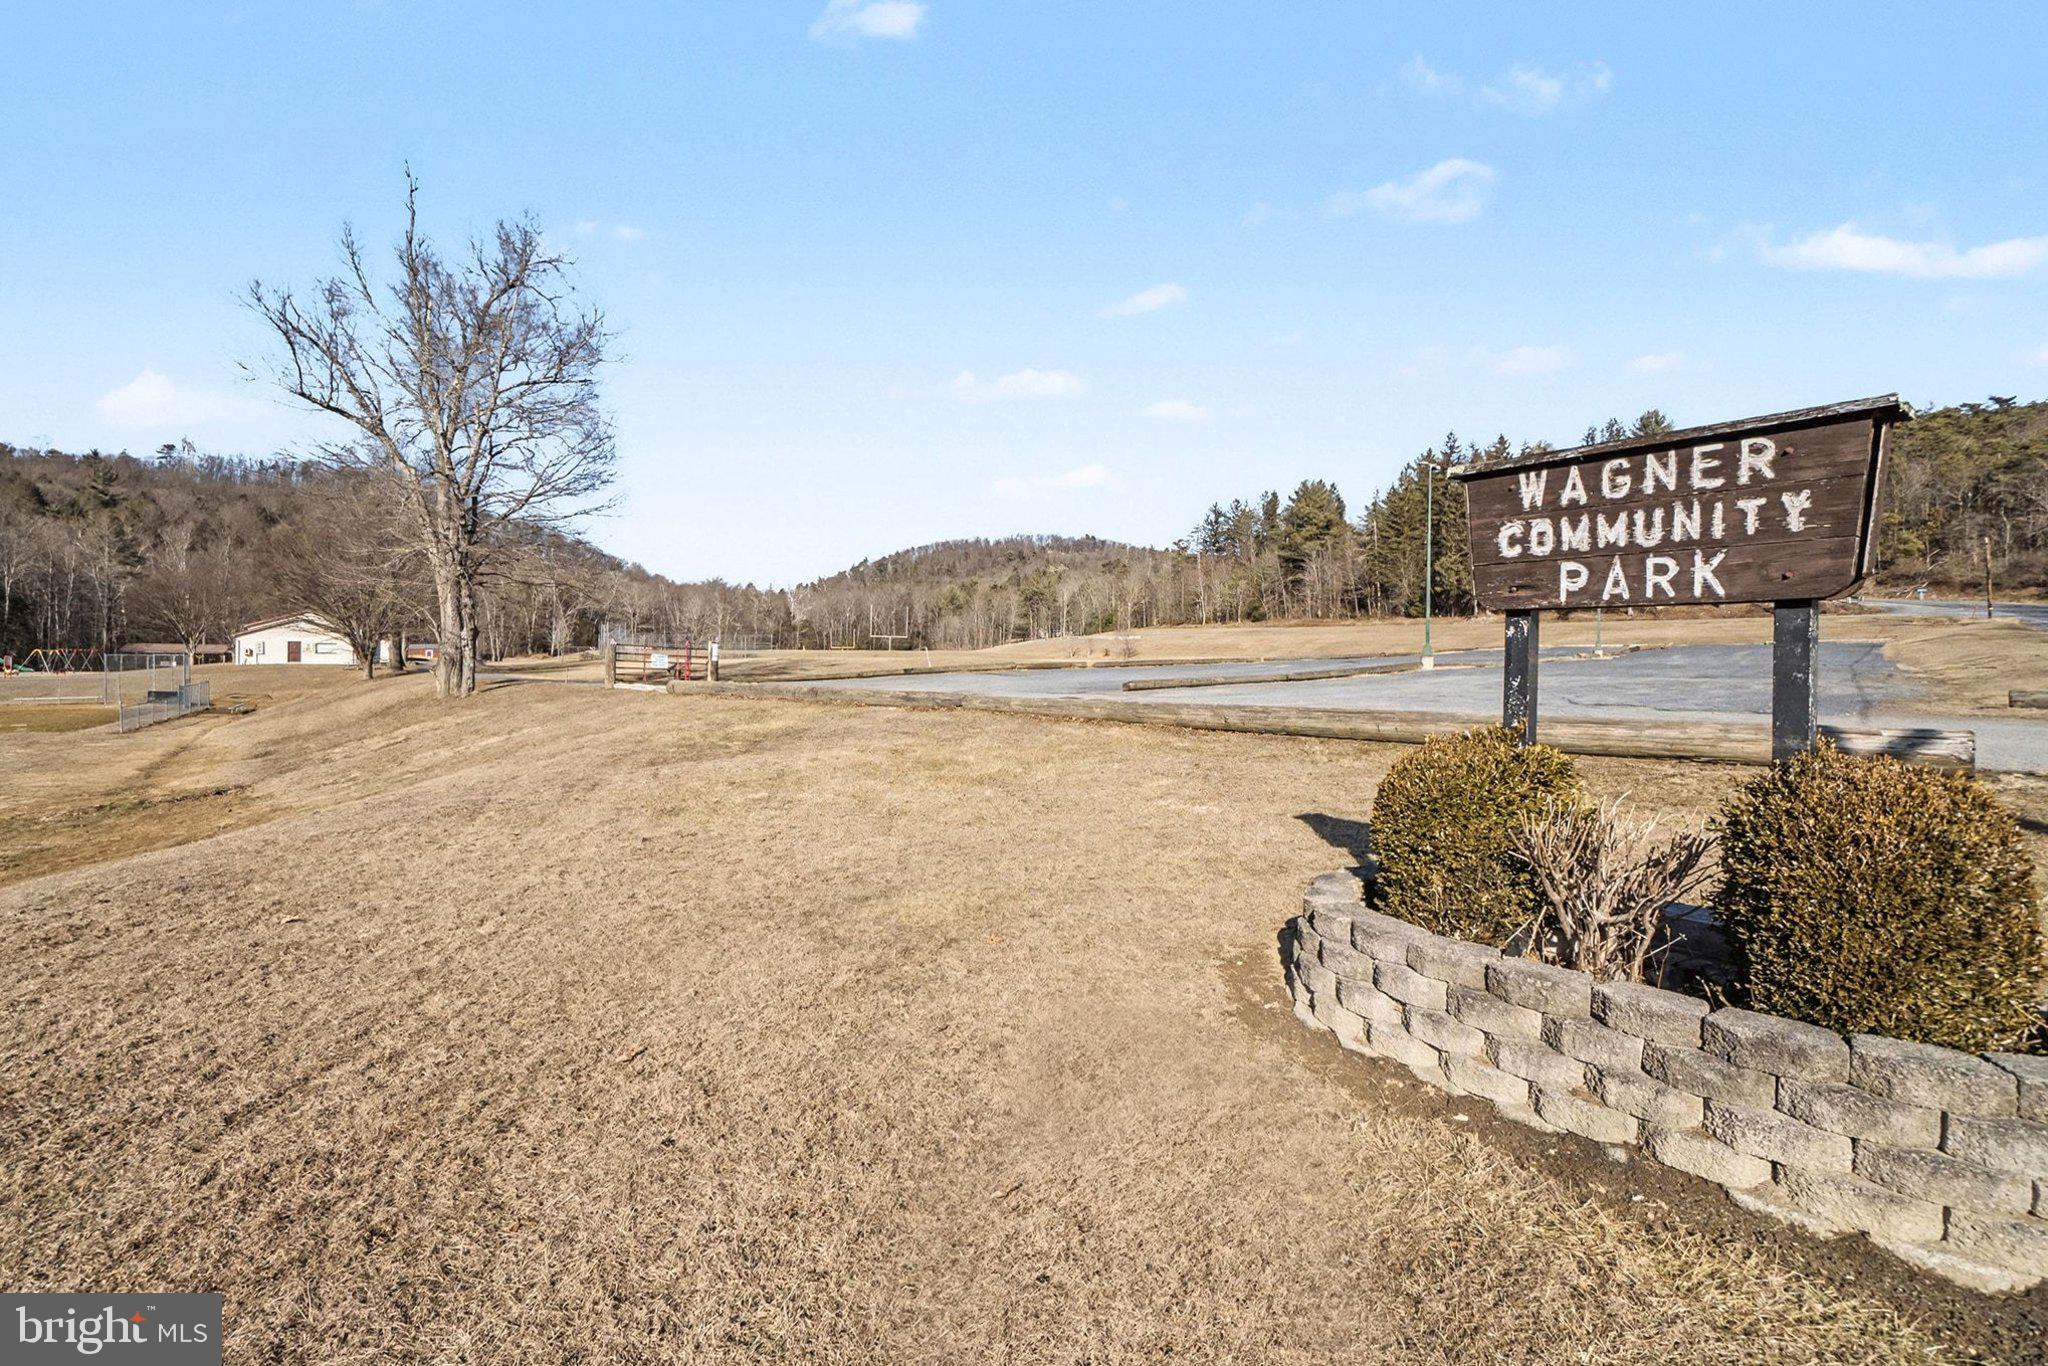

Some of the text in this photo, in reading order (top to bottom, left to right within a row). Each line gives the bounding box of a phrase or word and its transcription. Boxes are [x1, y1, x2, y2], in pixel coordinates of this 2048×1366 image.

[1518, 437, 1777, 511] WAGNER
[1498, 488, 1813, 558] COMMUNITY
[1559, 549, 1728, 603] PARK
